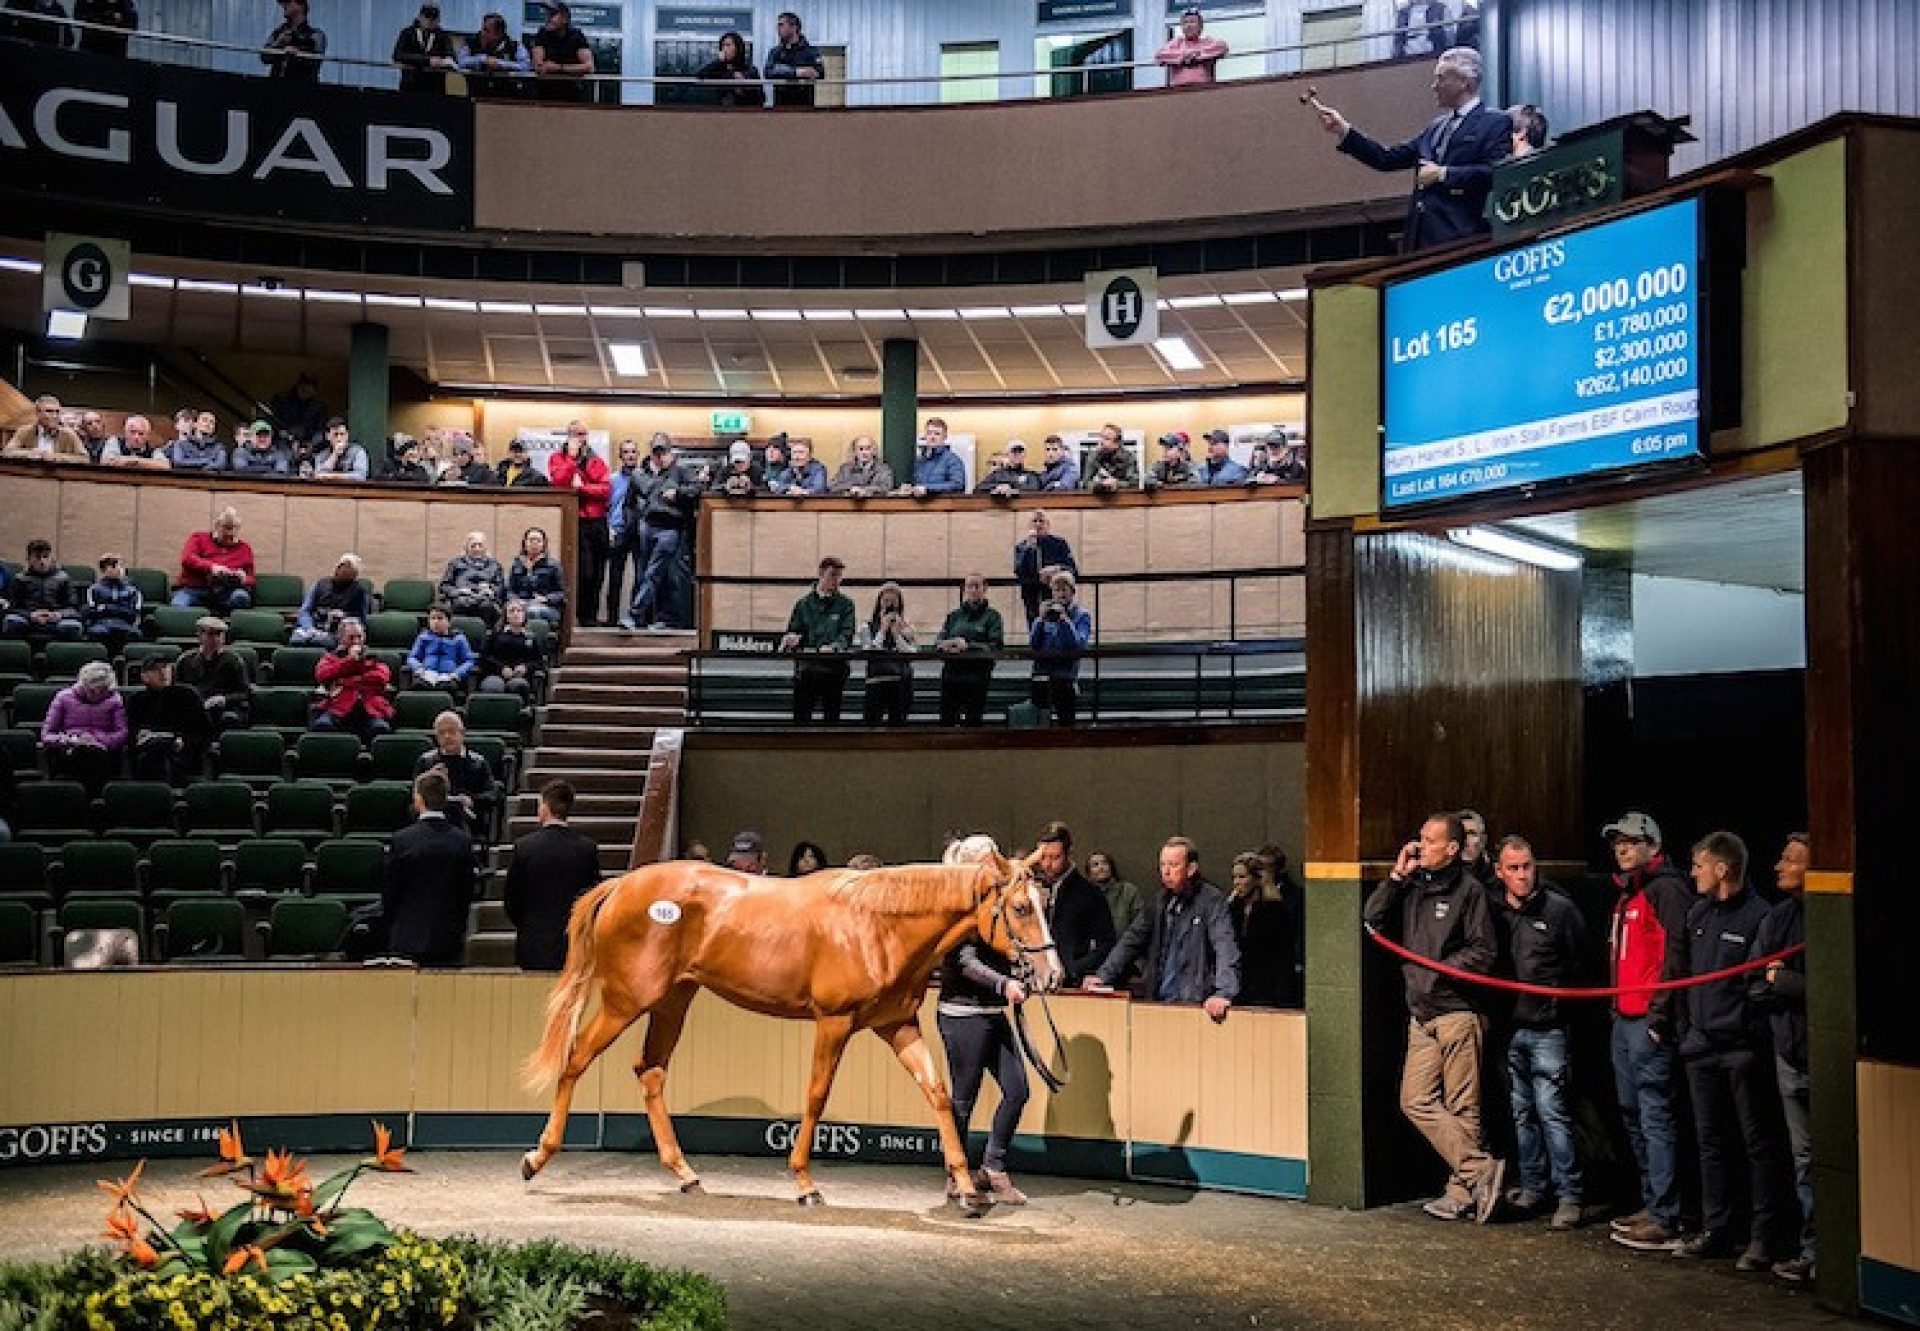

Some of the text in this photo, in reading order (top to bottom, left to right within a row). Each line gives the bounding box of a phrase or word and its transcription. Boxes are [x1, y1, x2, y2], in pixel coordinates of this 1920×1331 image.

[68, 258, 102, 293] G
[1494, 240, 1565, 282] GOFFS
[1107, 290, 1138, 325] H
[1544, 263, 1687, 324] €2,000,000
[1392, 316, 1478, 364] Lot 165
[1594, 301, 1688, 342] £1,780,000
[1594, 329, 1688, 369] $2,300,000
[1576, 356, 1688, 397] ¥262,140,000
[1664, 433, 1688, 453] pm
[0, 1123, 107, 1160] GOFFS
[130, 1127, 185, 1145] SINCE
[765, 1120, 862, 1155] GFFS
